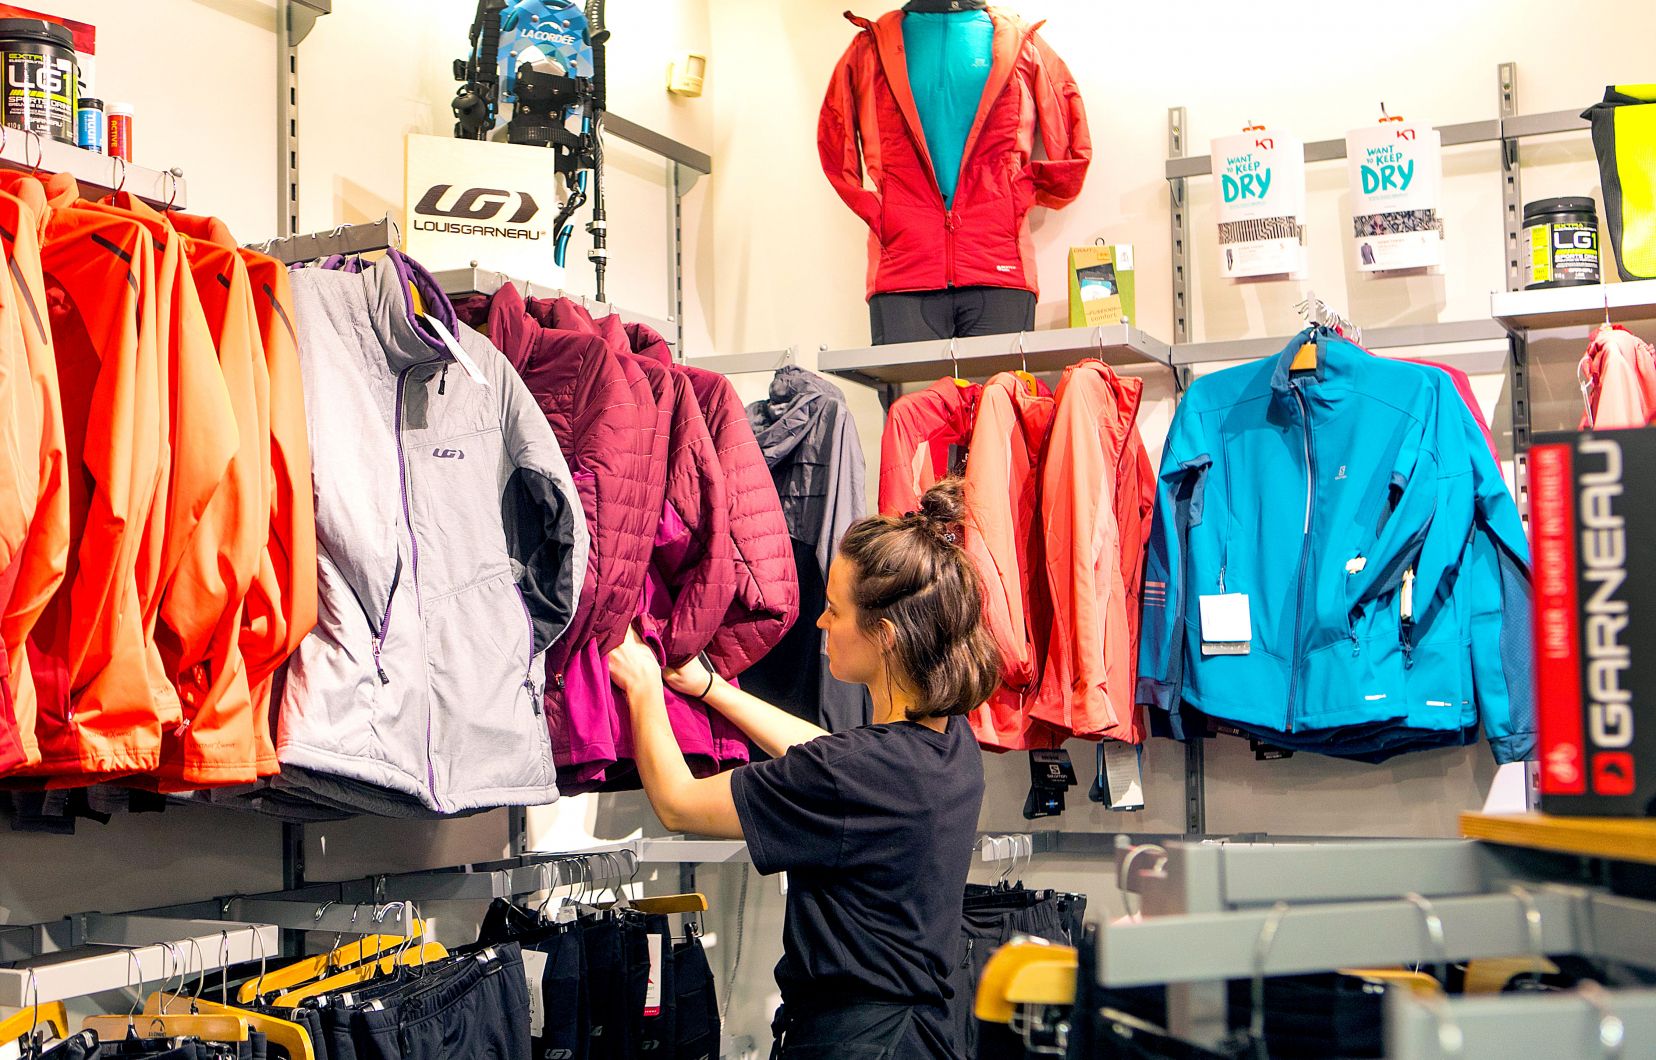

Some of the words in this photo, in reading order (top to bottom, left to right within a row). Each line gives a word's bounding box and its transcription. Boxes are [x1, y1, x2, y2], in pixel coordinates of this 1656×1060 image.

[8, 53, 46, 61] EXTR
[1366, 144, 1394, 156] WANT
[1226, 153, 1252, 166] WANT
[1376, 152, 1403, 167] KEEP
[1235, 160, 1260, 175] KEEP
[1360, 158, 1414, 195] DRY
[1221, 167, 1271, 203] DRY
[1553, 231, 1597, 249] LG1
[1578, 439, 1634, 748] GARNEAU
